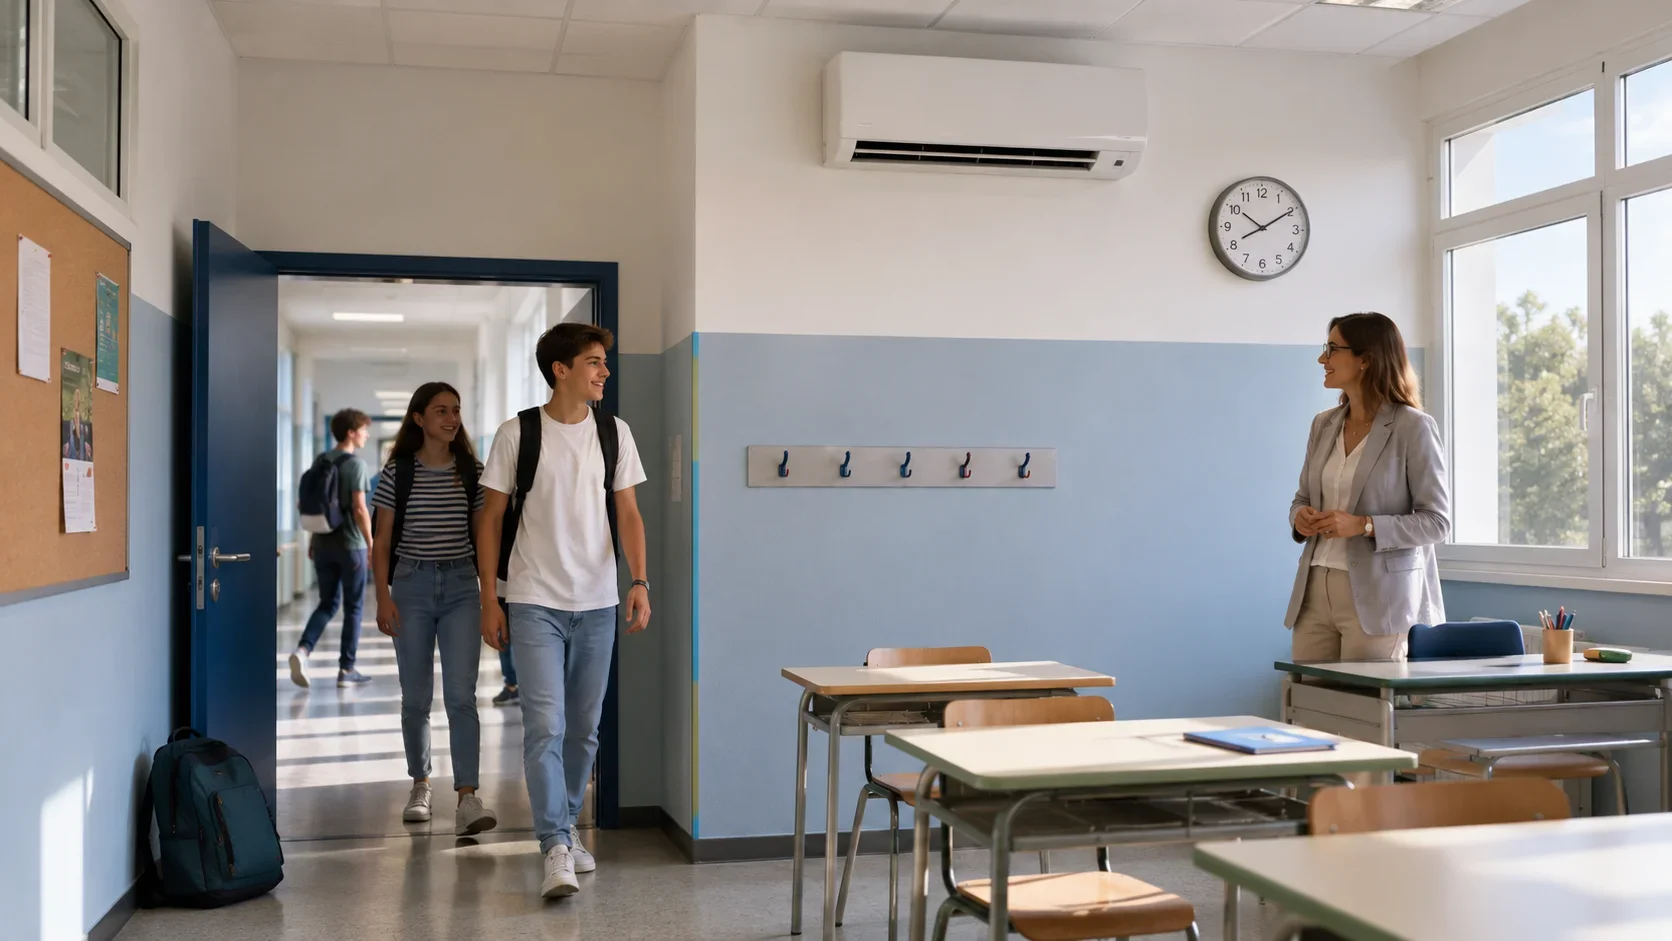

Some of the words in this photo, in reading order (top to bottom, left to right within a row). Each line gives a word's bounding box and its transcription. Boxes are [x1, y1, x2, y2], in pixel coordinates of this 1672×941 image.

[1241, 192, 1250, 202] 11
[1257, 188, 1267, 199] 12
[1276, 194, 1280, 204] 1
[1229, 204, 1241, 215] 10
[1287, 207, 1294, 217] 2
[1224, 221, 1231, 232] 9
[1292, 224, 1299, 235] 3
[1230, 240, 1238, 250] 8
[1287, 242, 1294, 252] 4
[1242, 253, 1250, 263] 7
[1276, 254, 1282, 264] 5
[1258, 258, 1266, 269] 6
